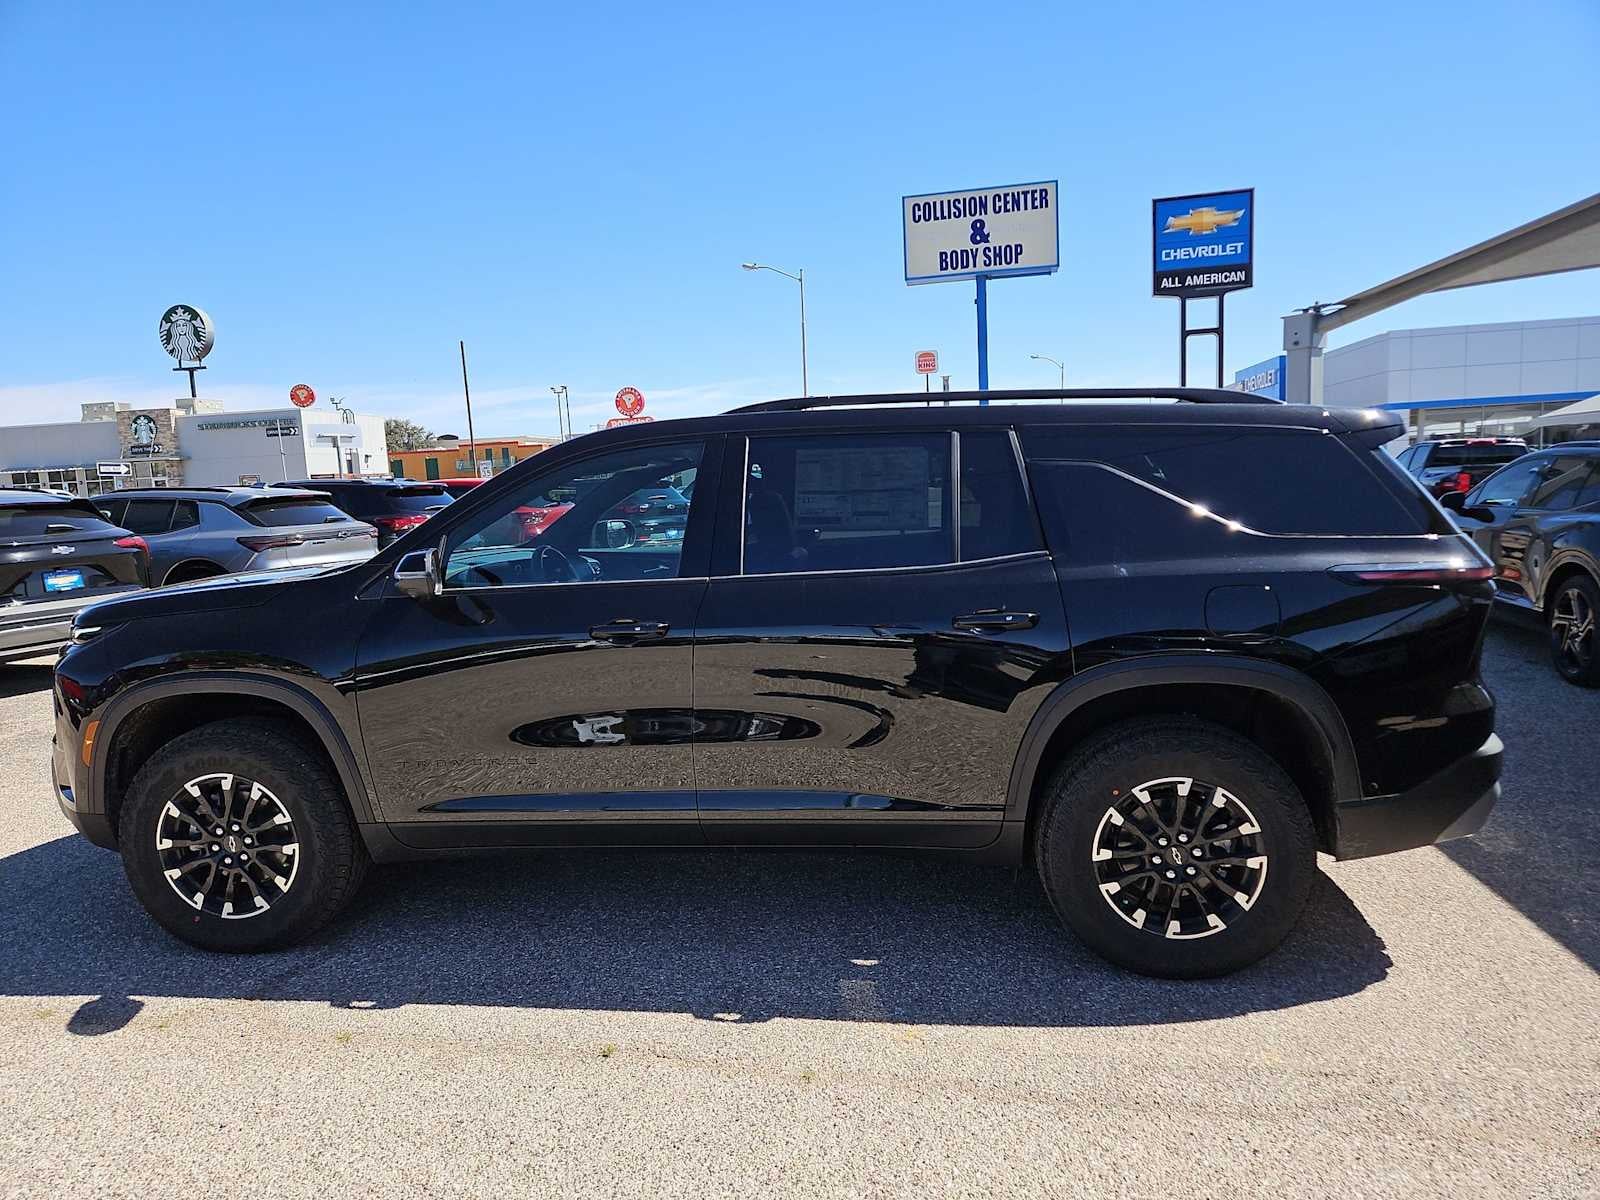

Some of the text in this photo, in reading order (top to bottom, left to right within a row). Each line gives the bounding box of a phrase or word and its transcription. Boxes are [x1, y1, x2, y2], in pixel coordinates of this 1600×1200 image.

[912, 188, 1049, 223] COLLISION CENTER
[969, 219, 990, 245] &
[939, 243, 1023, 272] BODY SHOP
[1161, 242, 1244, 261] CHEVROLET
[1160, 270, 1246, 288] ALL AMERICAN
[1244, 367, 1275, 392] CHEVROLET
